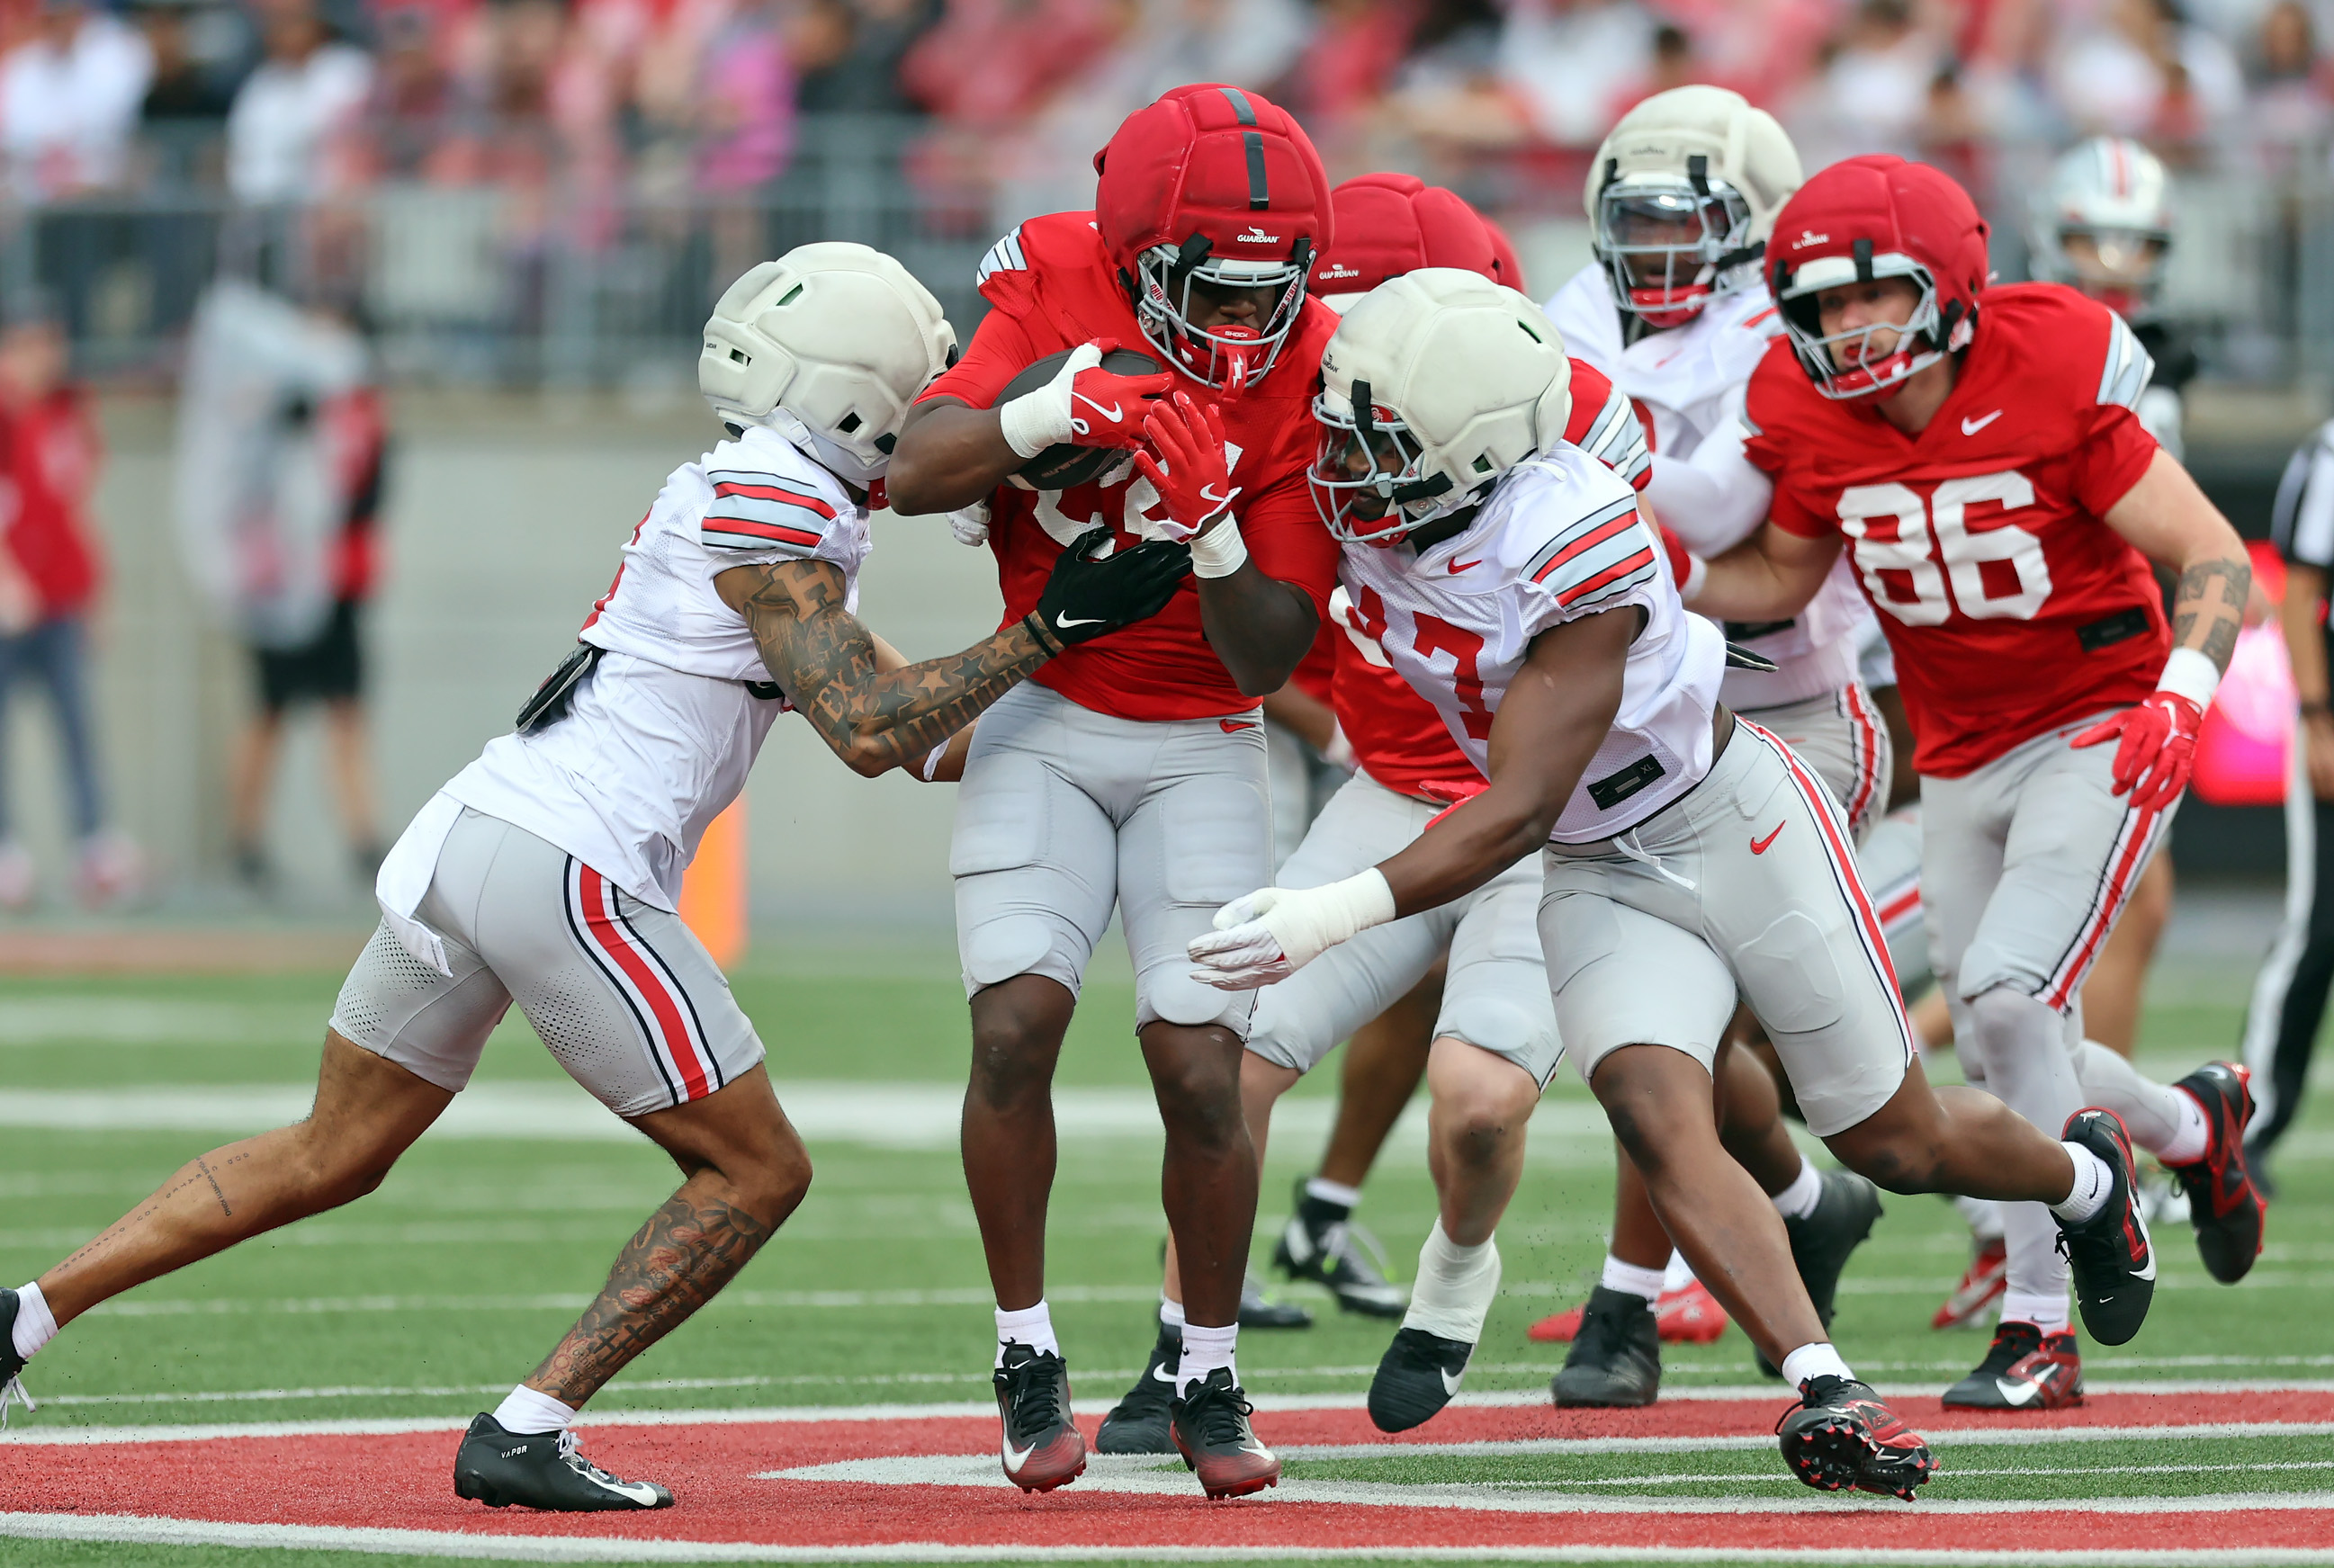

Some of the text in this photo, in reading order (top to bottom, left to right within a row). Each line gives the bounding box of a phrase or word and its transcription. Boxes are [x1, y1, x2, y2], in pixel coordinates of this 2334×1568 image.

[1236, 234, 1278, 244] GUARDIAN
[1224, 330, 1249, 338] SHOCK
[1836, 470, 2052, 627] 86
[1639, 764, 1655, 774] XL
[207, 1174, 223, 1200] WORTH
[220, 1198, 232, 1217] KING
[500, 1444, 528, 1460] VAPOR
